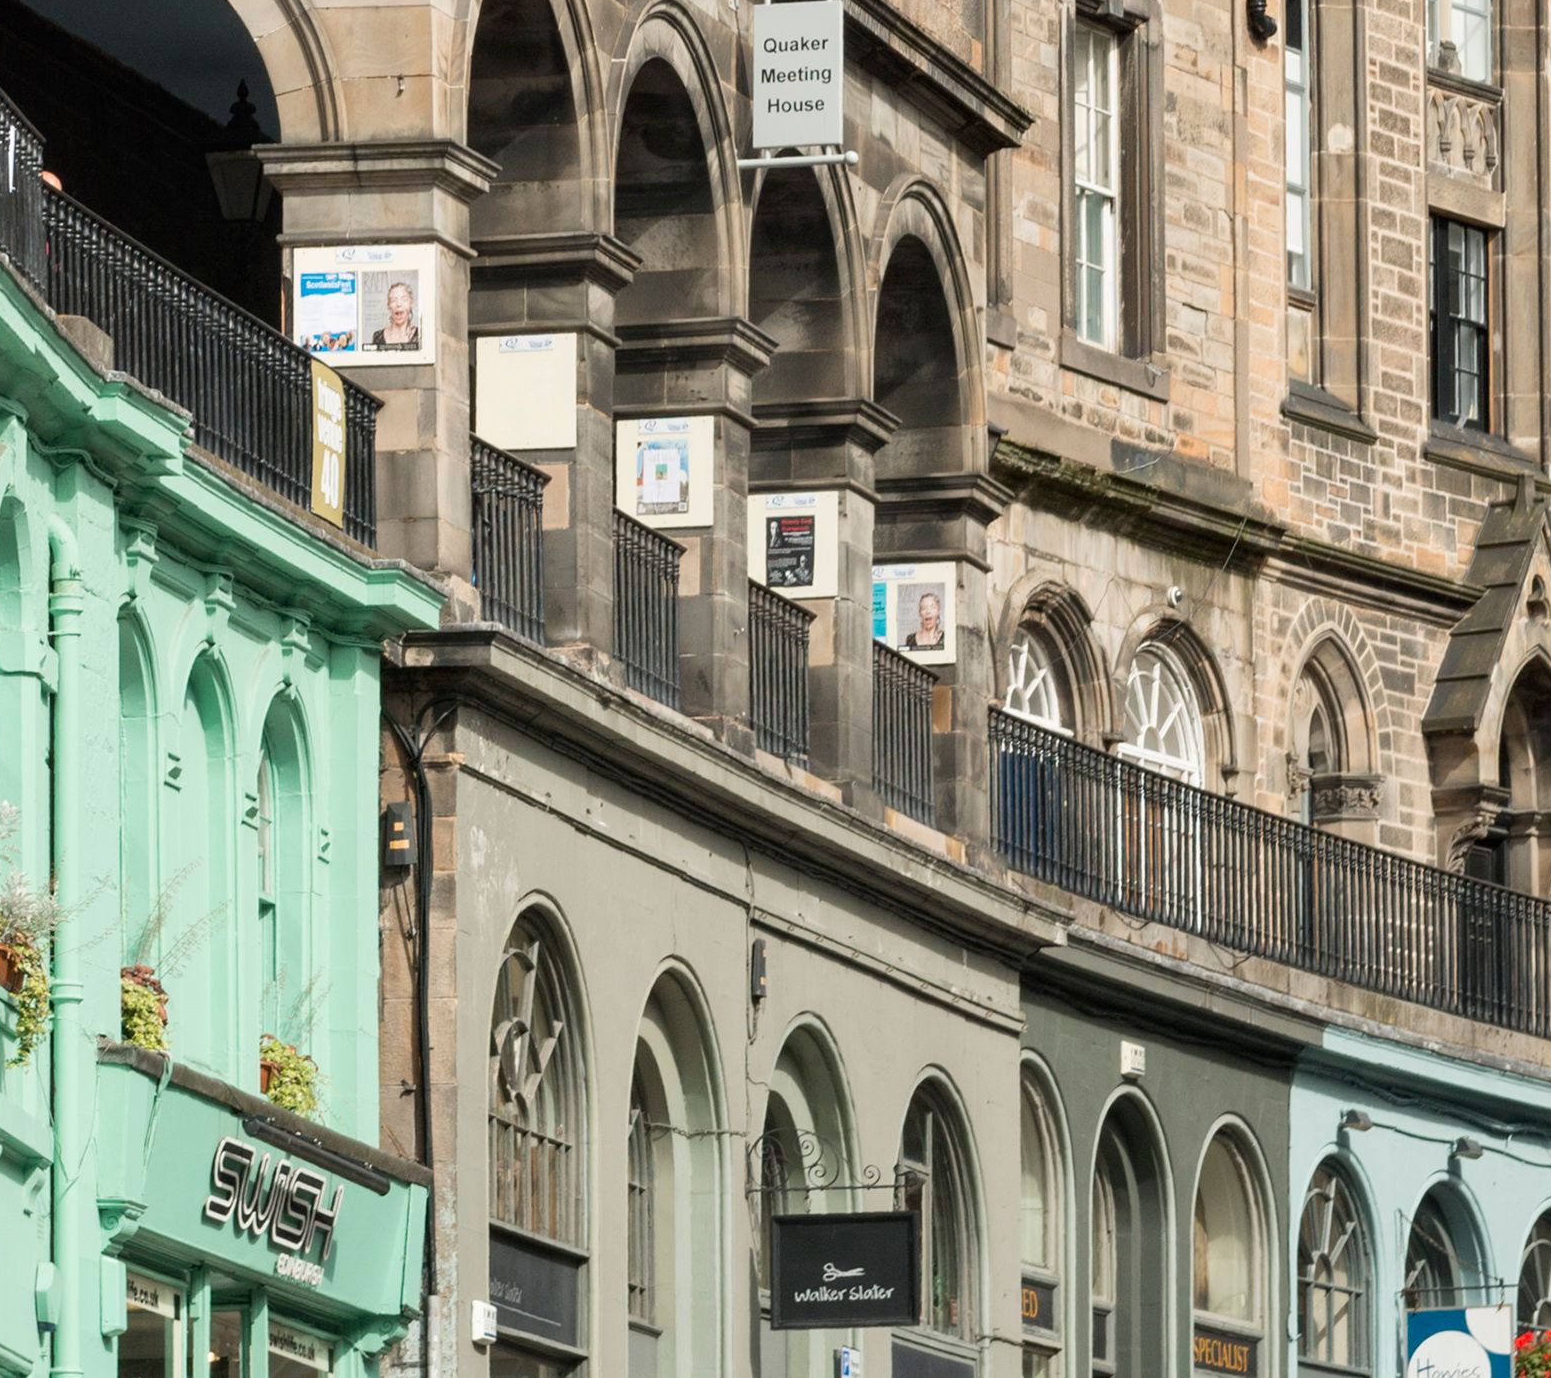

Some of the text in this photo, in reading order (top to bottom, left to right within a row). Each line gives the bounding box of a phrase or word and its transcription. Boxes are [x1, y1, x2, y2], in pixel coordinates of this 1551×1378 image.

[763, 36, 829, 54] Quaker
[761, 66, 832, 84] Meeting
[767, 98, 825, 113] House
[321, 449, 340, 509] 40
[206, 1136, 344, 1261] SWISH
[276, 1253, 324, 1286] EDINBURGH
[1194, 1337, 1250, 1374] SPECIALIST
